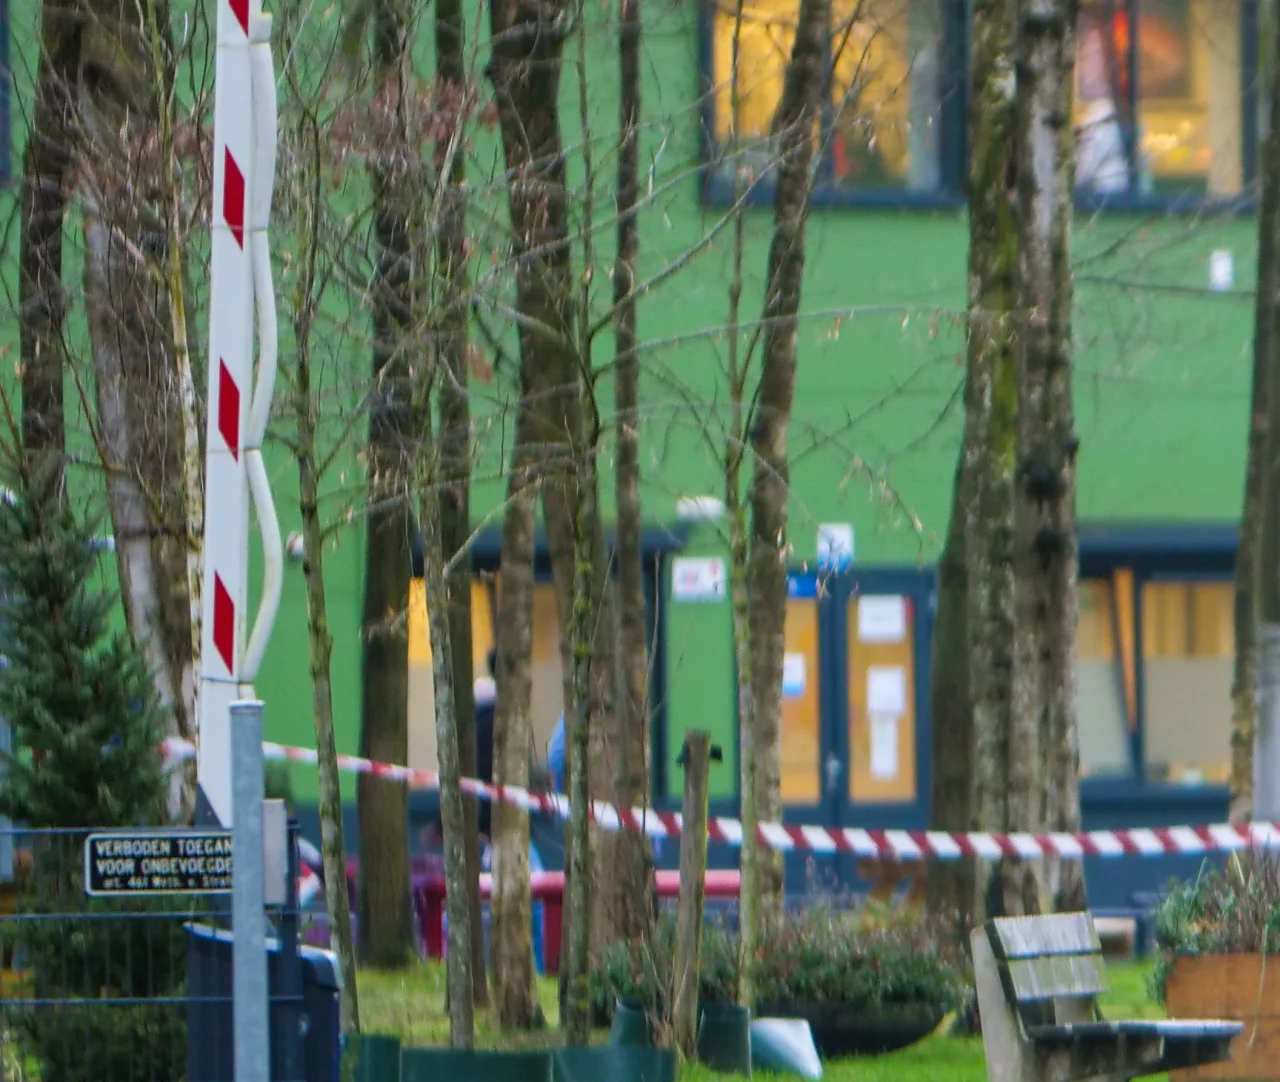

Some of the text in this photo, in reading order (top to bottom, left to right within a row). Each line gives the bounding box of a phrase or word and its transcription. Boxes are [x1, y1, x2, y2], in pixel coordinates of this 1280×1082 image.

[95, 839, 232, 857] VERBODEN TOEGAN
[96, 857, 232, 875] VOOR ONBEVOEGDE
